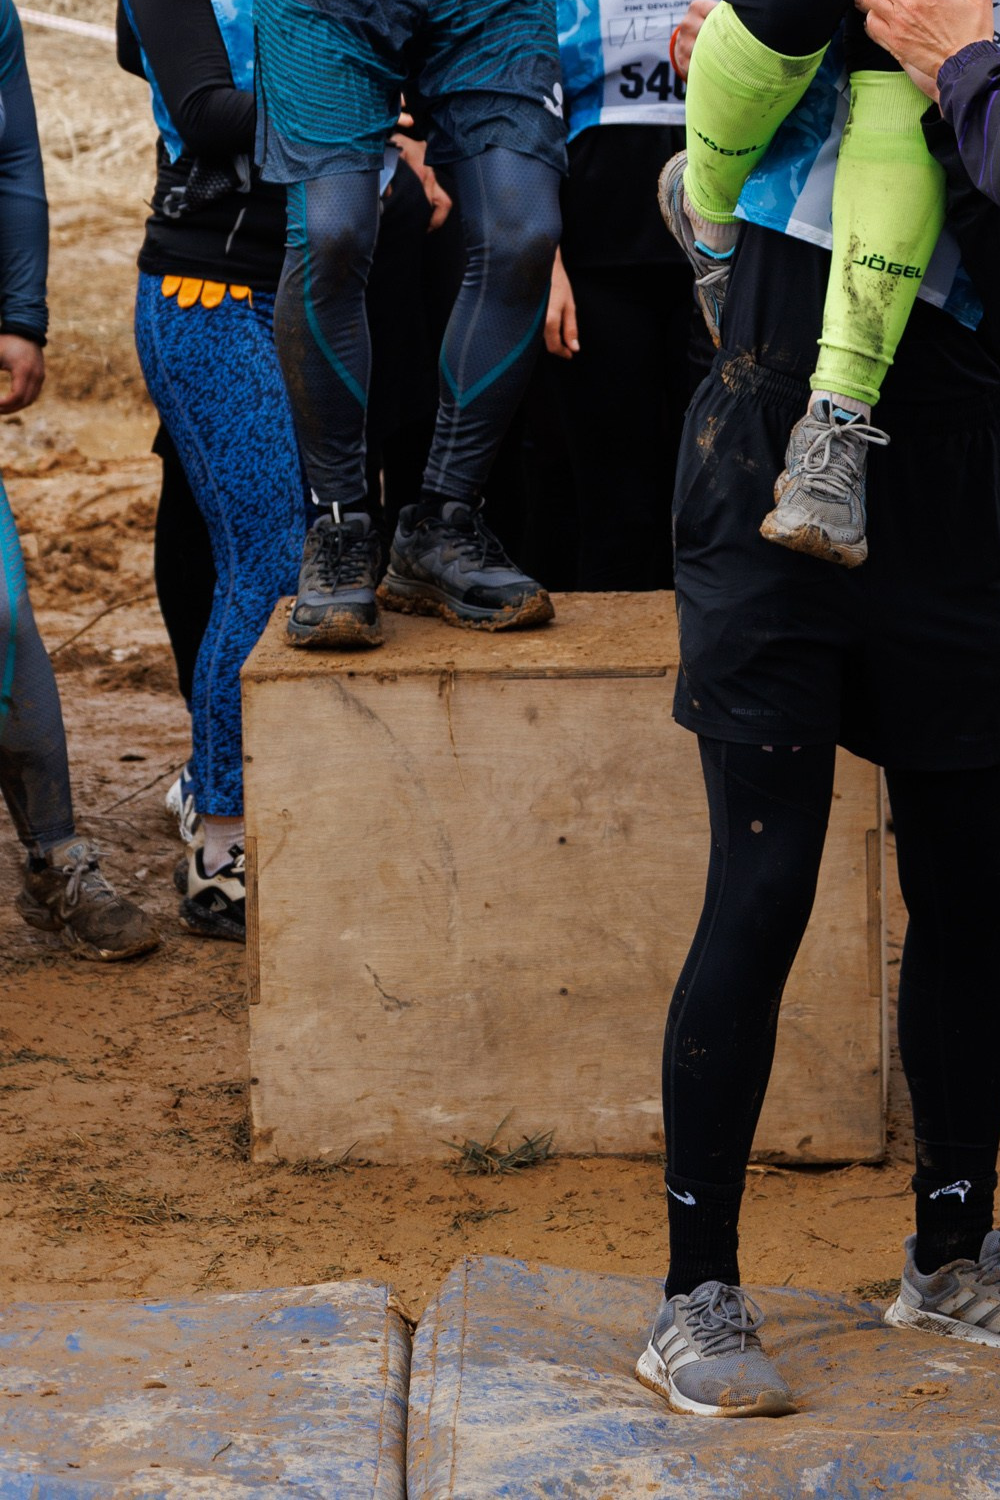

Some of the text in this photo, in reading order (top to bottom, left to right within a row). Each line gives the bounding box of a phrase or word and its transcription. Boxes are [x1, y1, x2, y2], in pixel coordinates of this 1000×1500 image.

[647, 0, 691, 10] DEVELOP
[620, 61, 687, 101] 54
[852, 253, 923, 279] JÖGEL
